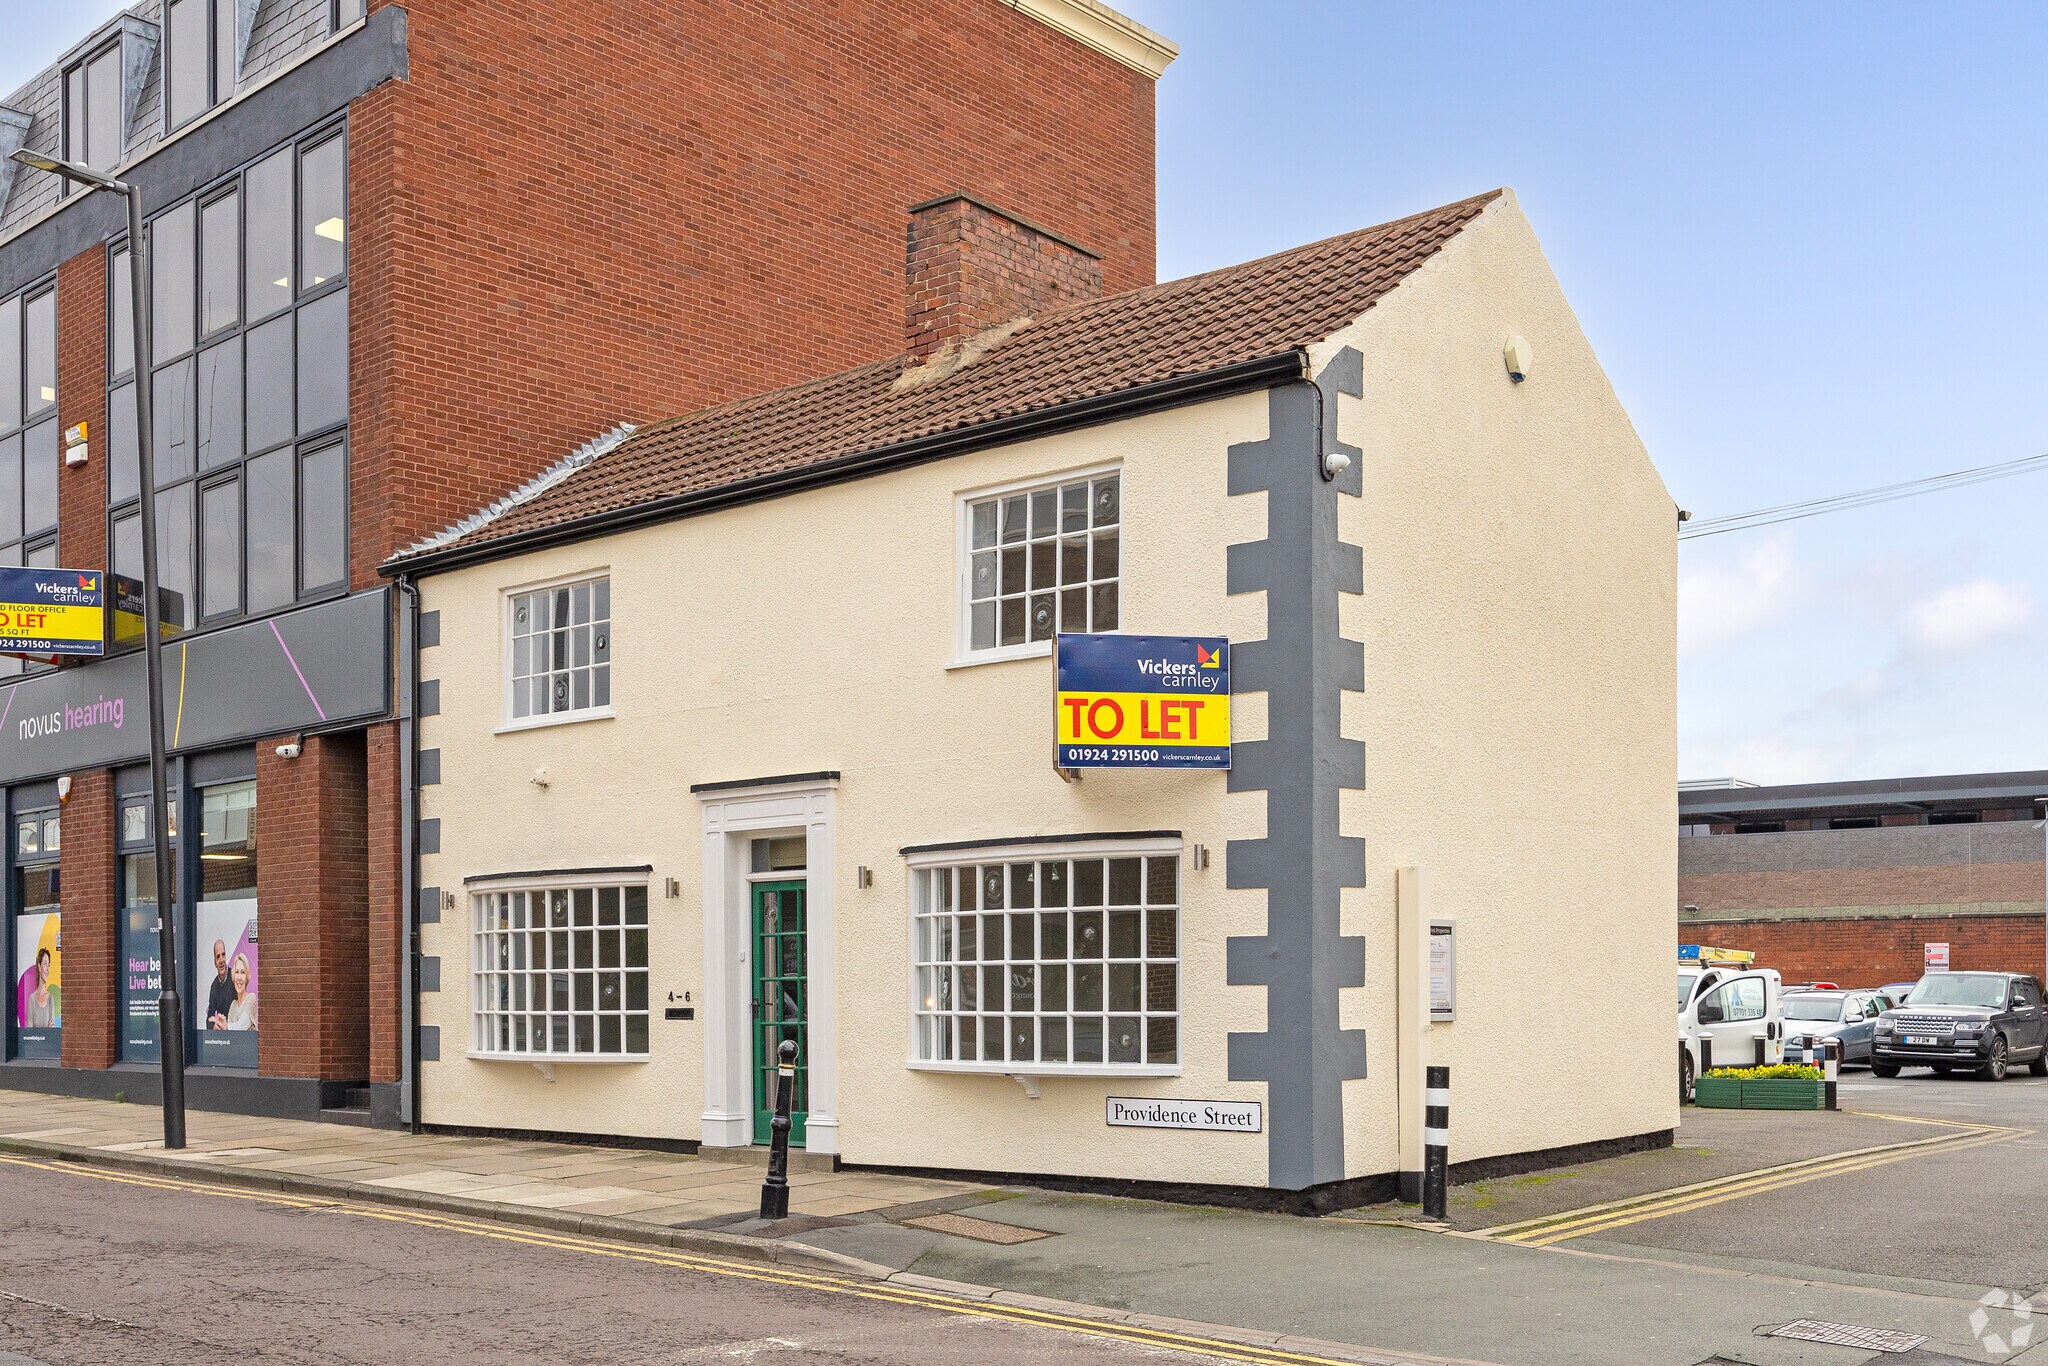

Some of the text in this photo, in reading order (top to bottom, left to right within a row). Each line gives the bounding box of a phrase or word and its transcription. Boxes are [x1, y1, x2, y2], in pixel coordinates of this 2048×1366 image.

[35, 583, 78, 594] Vickers
[53, 592, 95, 605] carnley
[17, 614, 47, 628] LET
[16, 640, 50, 648] 291500
[1137, 659, 1196, 675] Vickers
[1162, 672, 1220, 692] carnley
[20, 695, 124, 740] novus hearing
[1064, 698, 1204, 739] TO LET
[1068, 749, 1221, 762] 01924 291500 vickerscarnley.co.uk
[129, 958, 149, 972] Hear
[129, 976, 146, 990] Live
[1114, 1104, 1252, 1126] Providence Street
